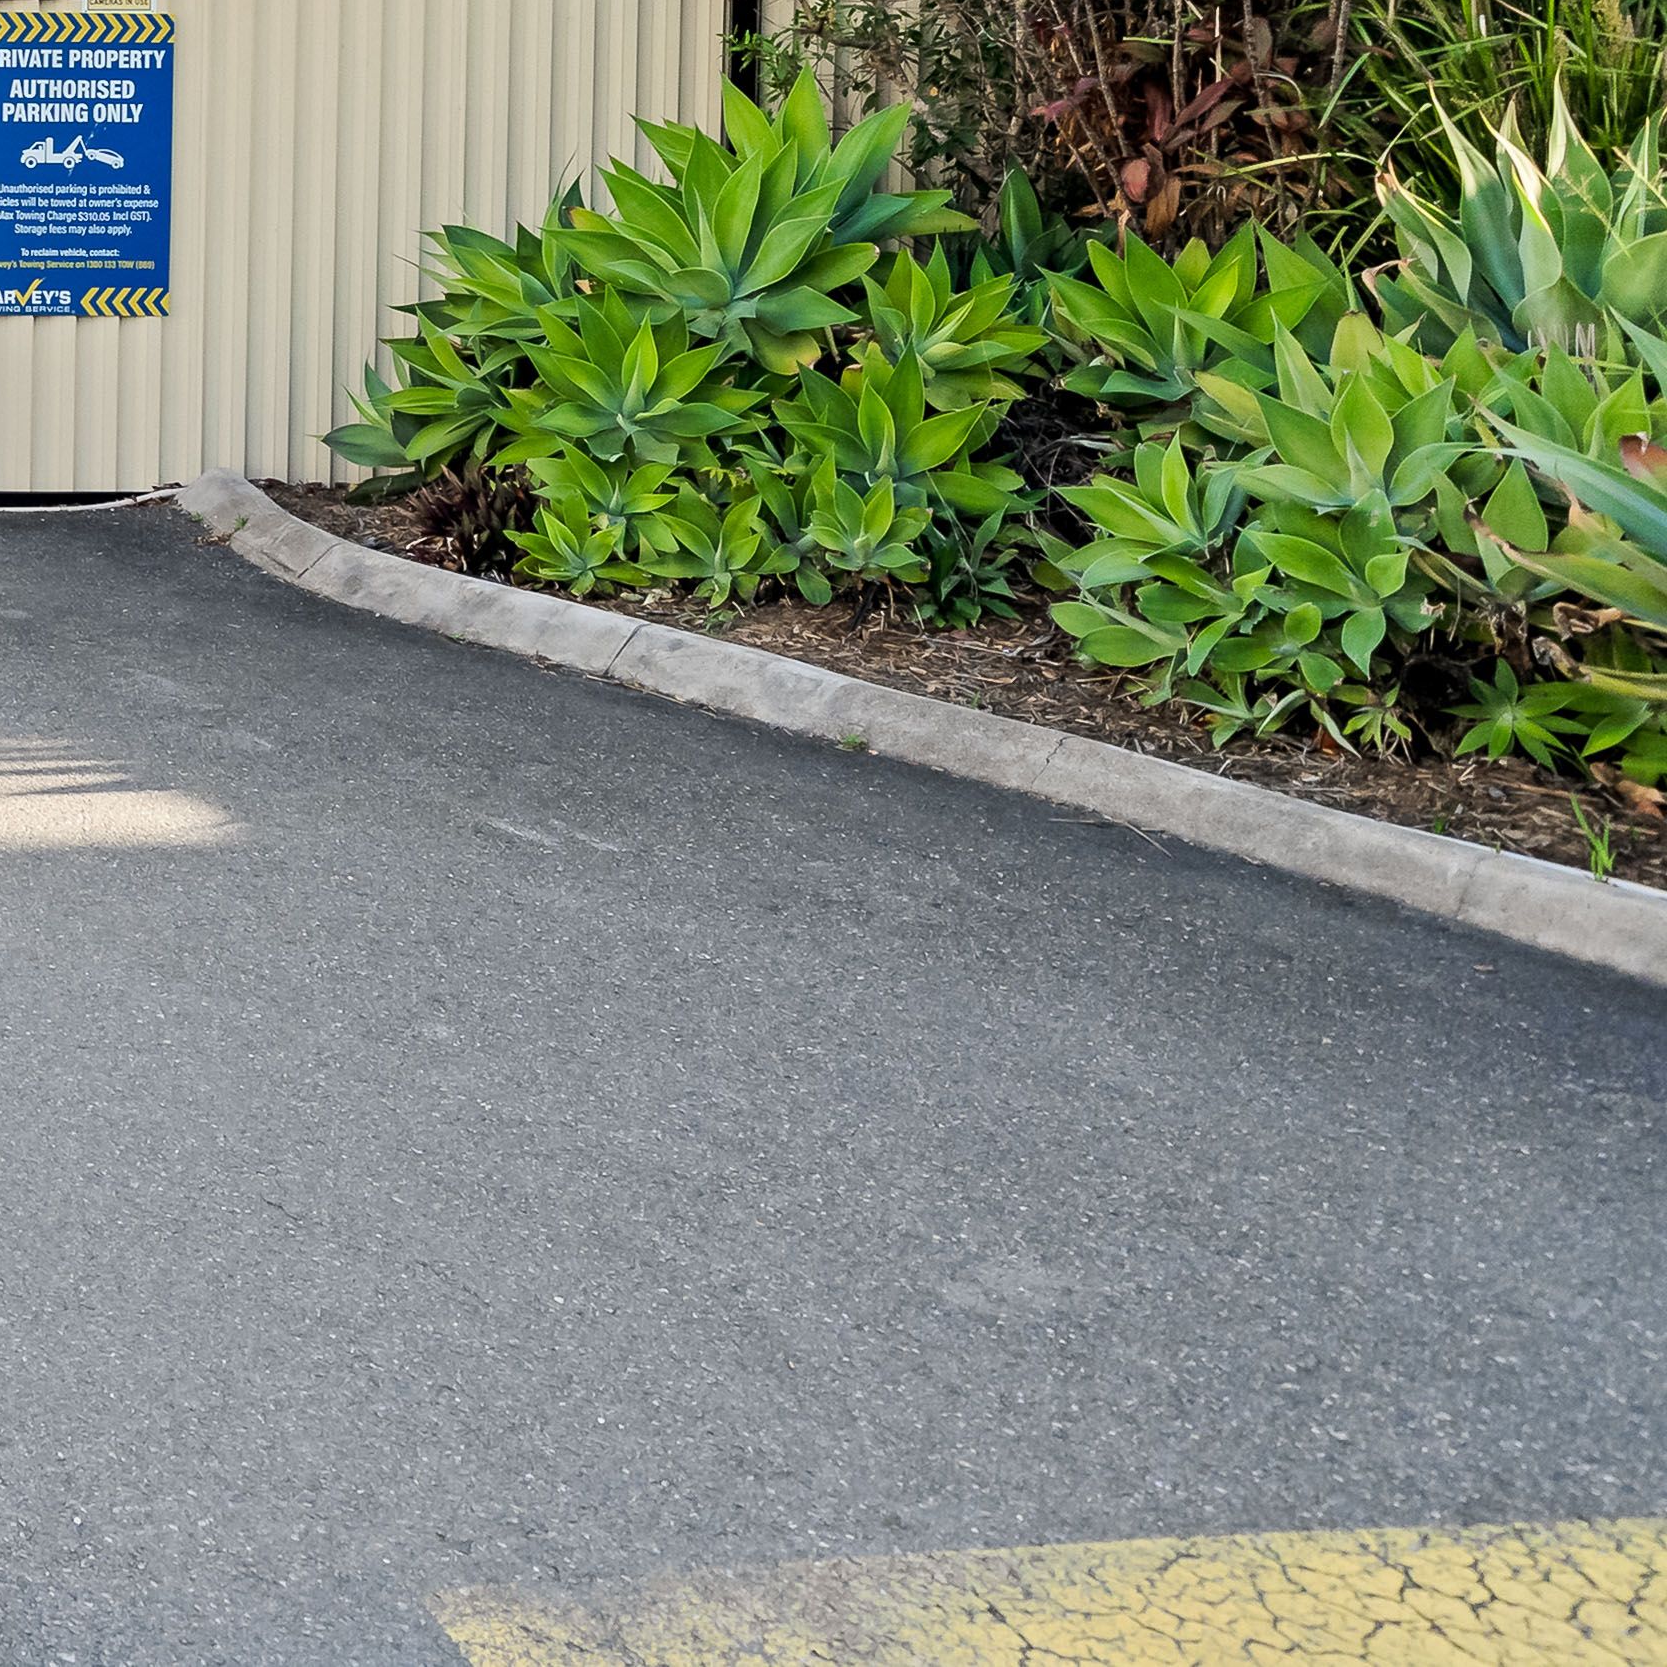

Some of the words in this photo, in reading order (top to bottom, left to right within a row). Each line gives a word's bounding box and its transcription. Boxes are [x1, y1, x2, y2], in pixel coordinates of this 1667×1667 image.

[68, 50, 166, 69] PROPERTY
[9, 79, 136, 99] AUTHORISED
[2, 103, 89, 123] PARKING
[93, 103, 143, 123] ONLY
[55, 184, 87, 196] parking
[90, 184, 97, 194] is
[98, 184, 142, 196] prohibited
[143, 185, 151, 194] &
[21, 197, 36, 207] will
[38, 197, 49, 207] be
[50, 197, 77, 207] towed
[78, 198, 87, 207] at
[89, 198, 122, 208] owner's
[123, 199, 159, 209] expense
[15, 210, 45, 222] Towing
[47, 210, 77, 223] Charge
[78, 211, 110, 222] $310.05
[113, 211, 129, 221] Incl
[130, 211, 153, 222] GST).
[14, 223, 48, 236] Storage
[49, 224, 67, 234] fees
[68, 225, 87, 236] may
[88, 224, 106, 234] also
[107, 224, 133, 236] apply.
[20, 248, 29, 257] To
[30, 248, 59, 257] reclaim
[60, 248, 88, 257] vehicle,
[89, 248, 120, 257] contact:
[19, 260, 45, 270] Towing
[46, 260, 74, 269] Service
[75, 261, 85, 269] on
[24, 305, 71, 313] SERVICE
